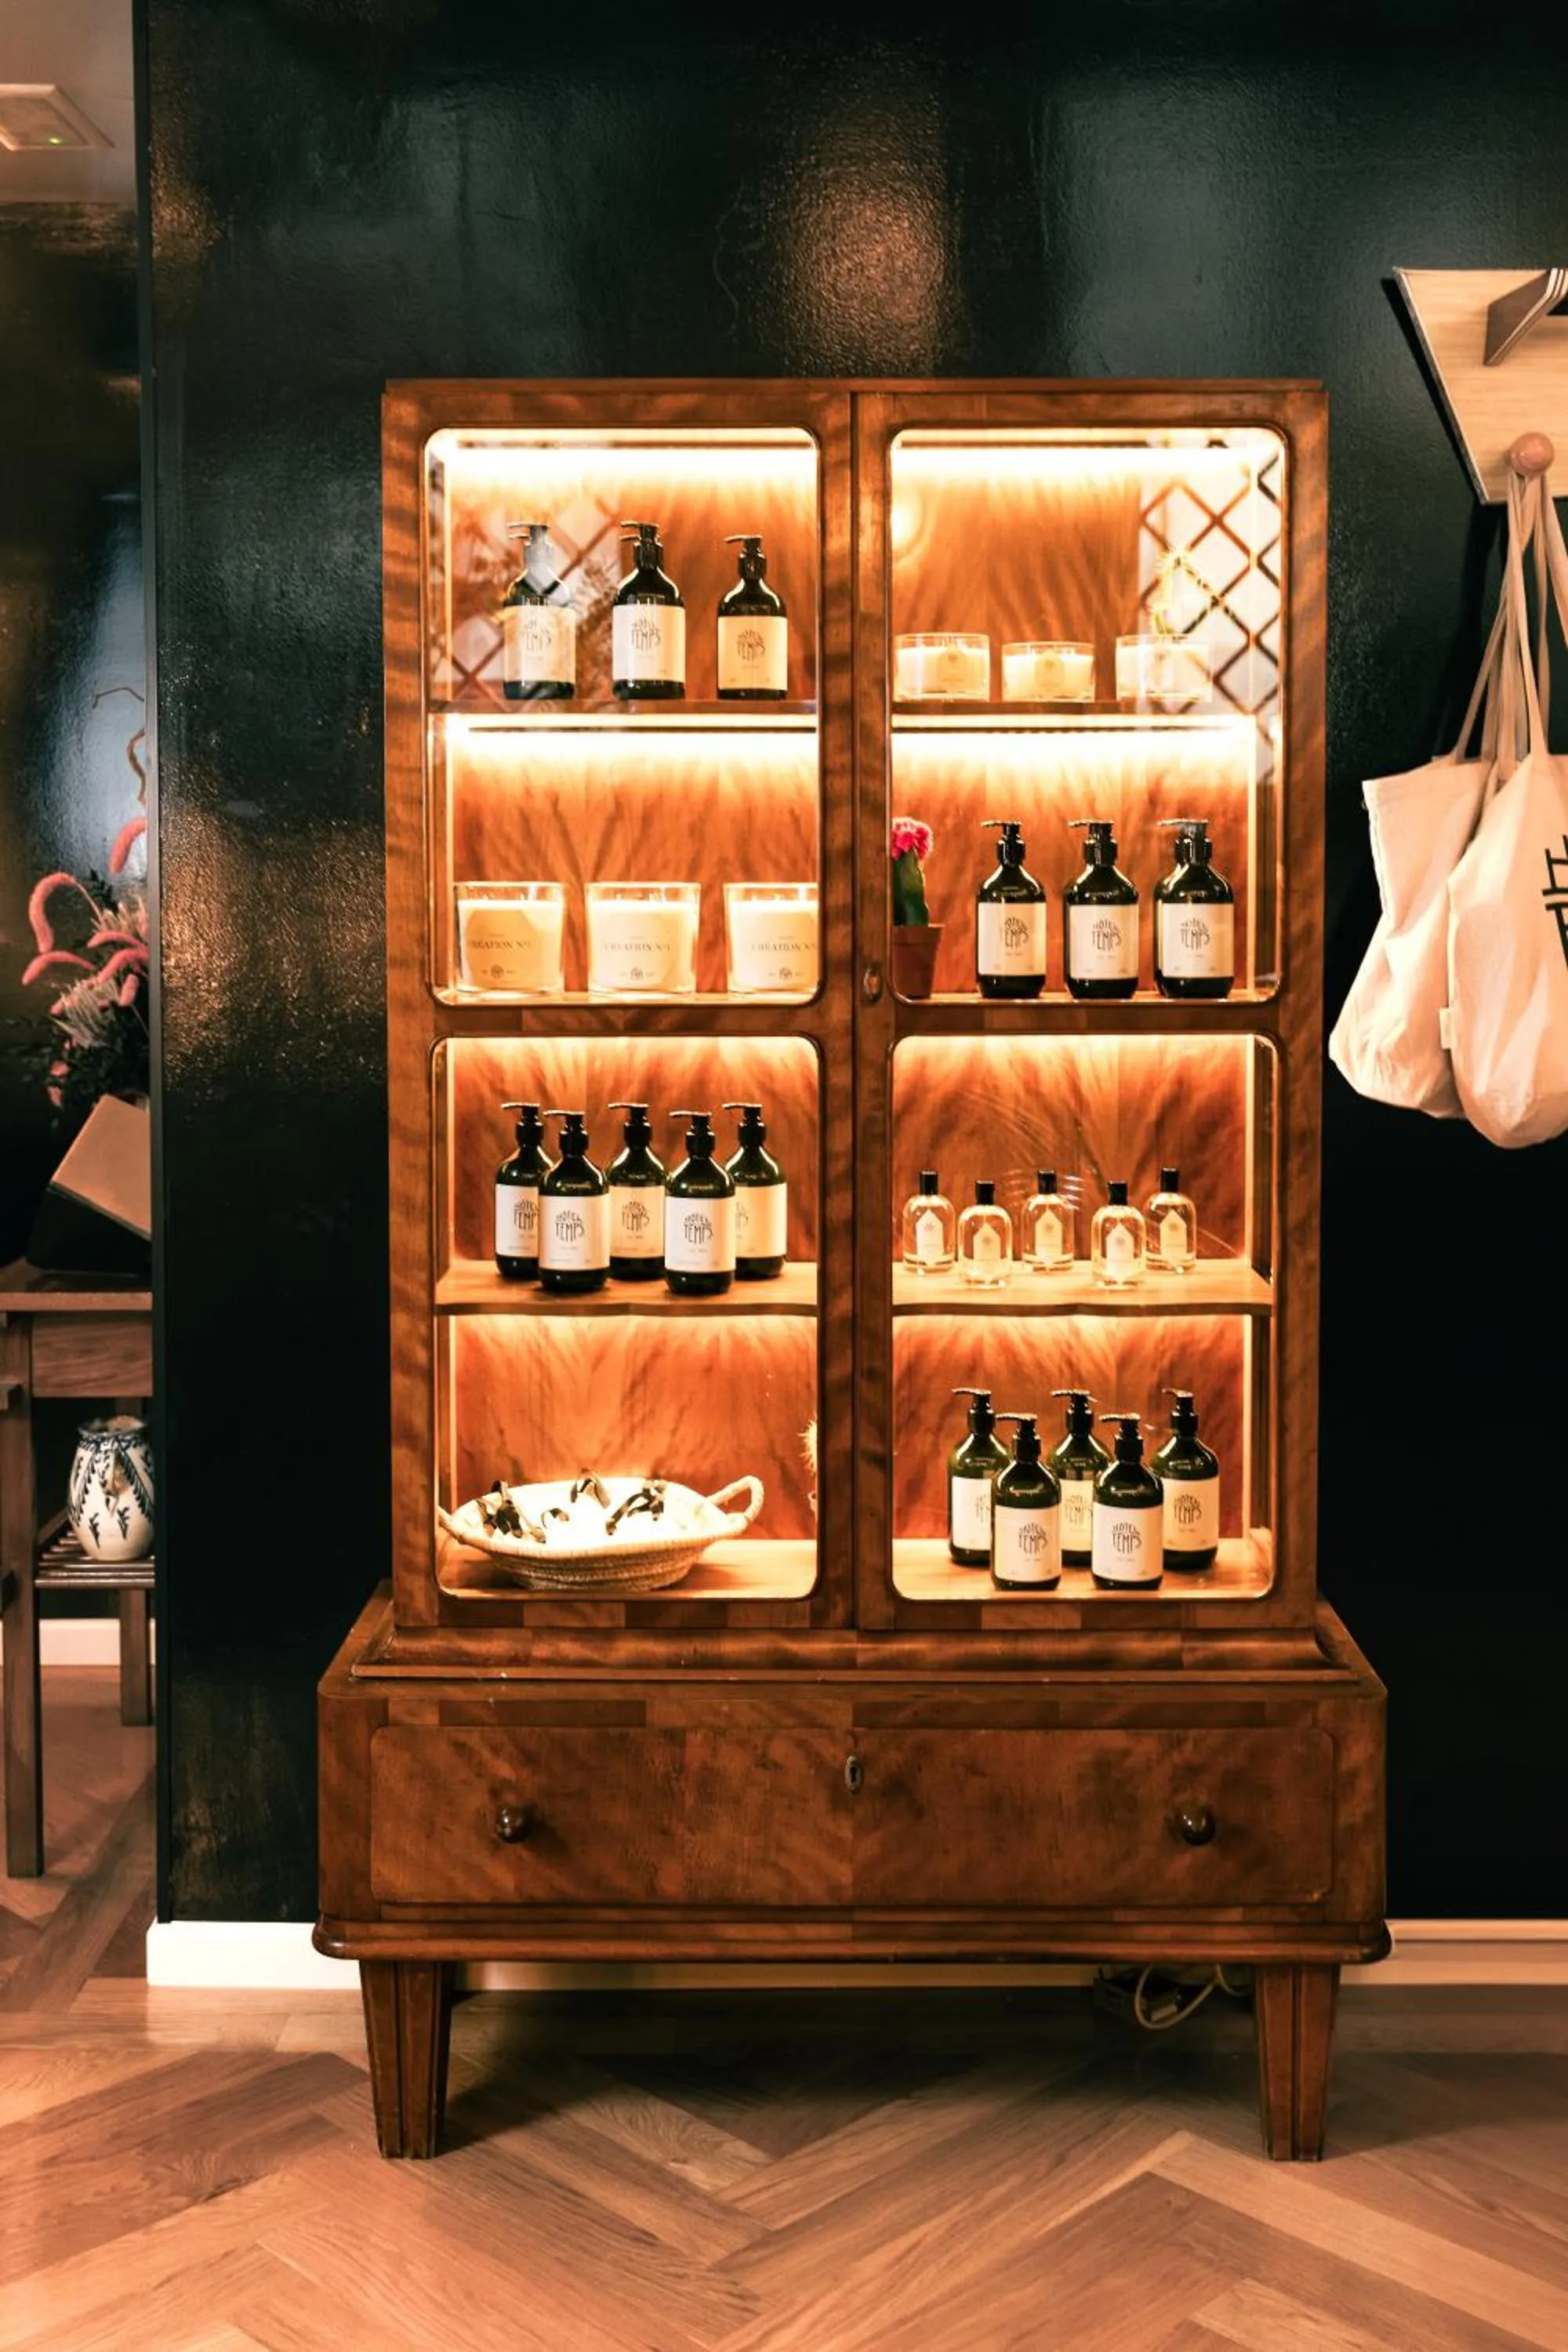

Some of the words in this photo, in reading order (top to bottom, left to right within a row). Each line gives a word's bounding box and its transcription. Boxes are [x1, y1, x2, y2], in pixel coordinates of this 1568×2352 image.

[514, 1209, 539, 1229] TEMP
[554, 1221, 585, 1242] TEMPS
[684, 1224, 713, 1244] TEMPS
[1174, 1504, 1202, 1524] TEMPS
[1112, 1532, 1142, 1553] TEMPS
